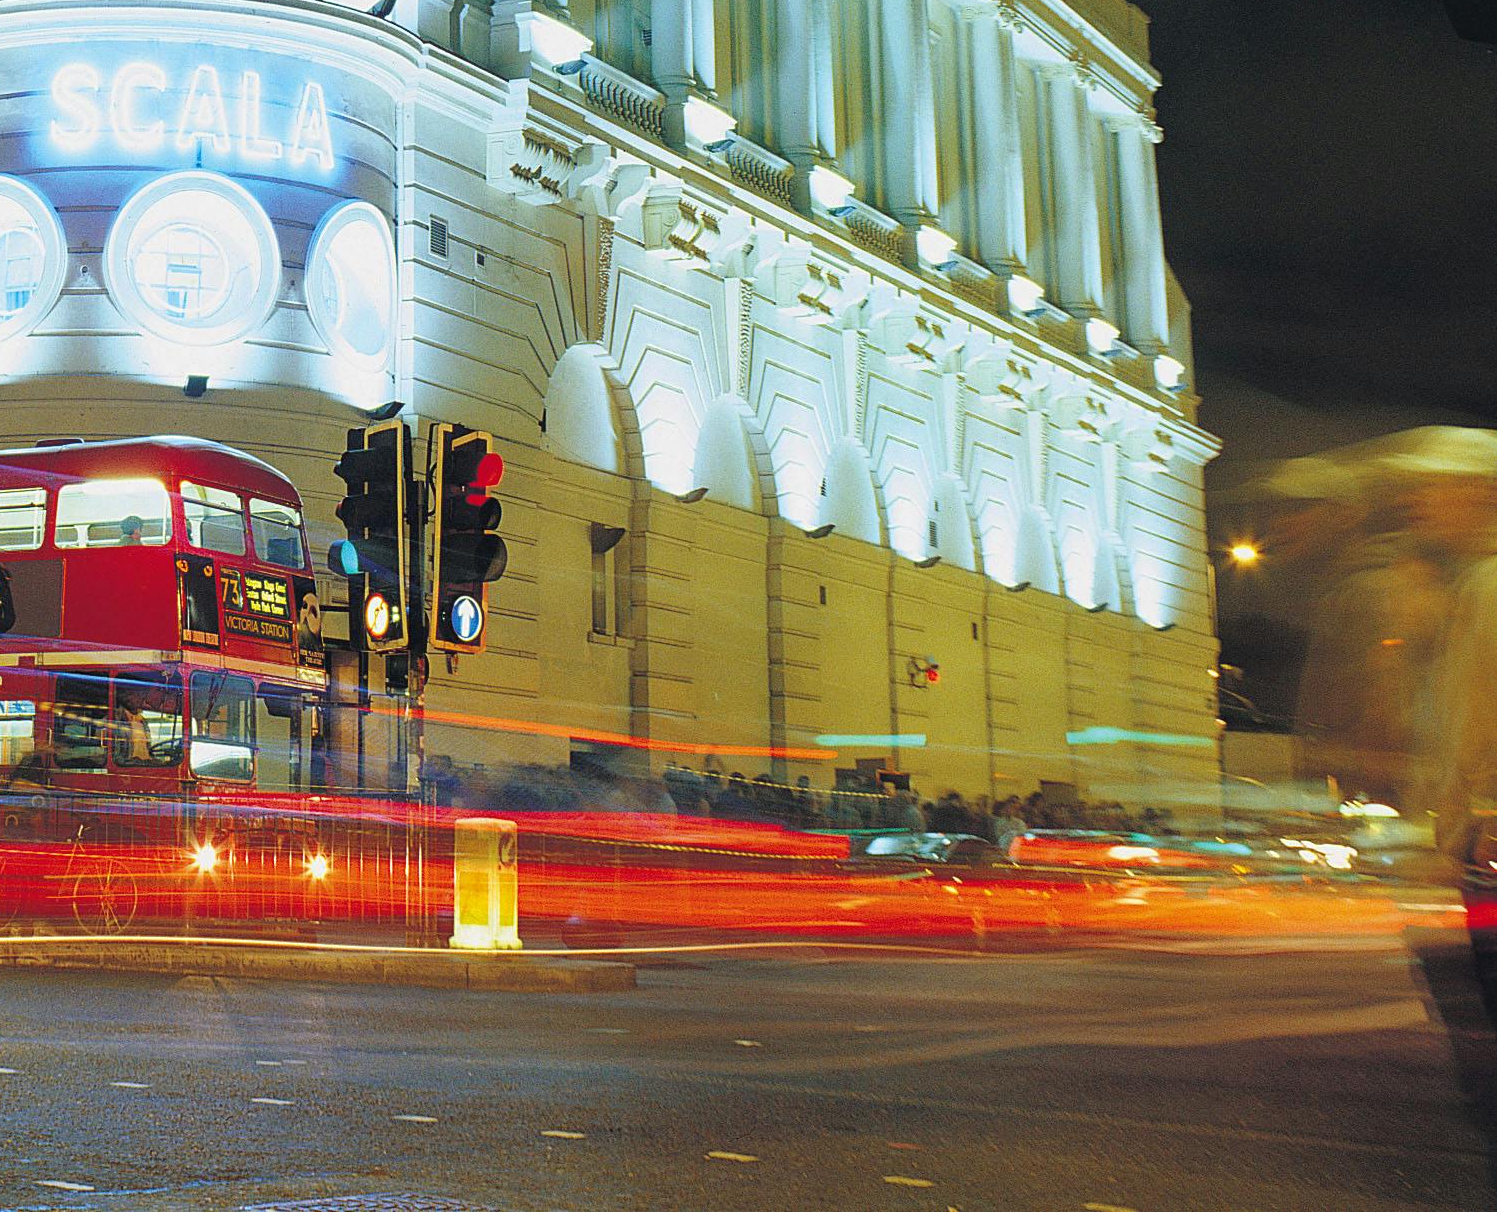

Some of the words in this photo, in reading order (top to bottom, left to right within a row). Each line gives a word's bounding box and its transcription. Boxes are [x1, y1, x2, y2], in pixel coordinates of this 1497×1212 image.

[49, 61, 335, 170] SCALA
[220, 577, 240, 605] 73
[225, 615, 259, 633] VICTORIA
[261, 621, 289, 638] STATION
